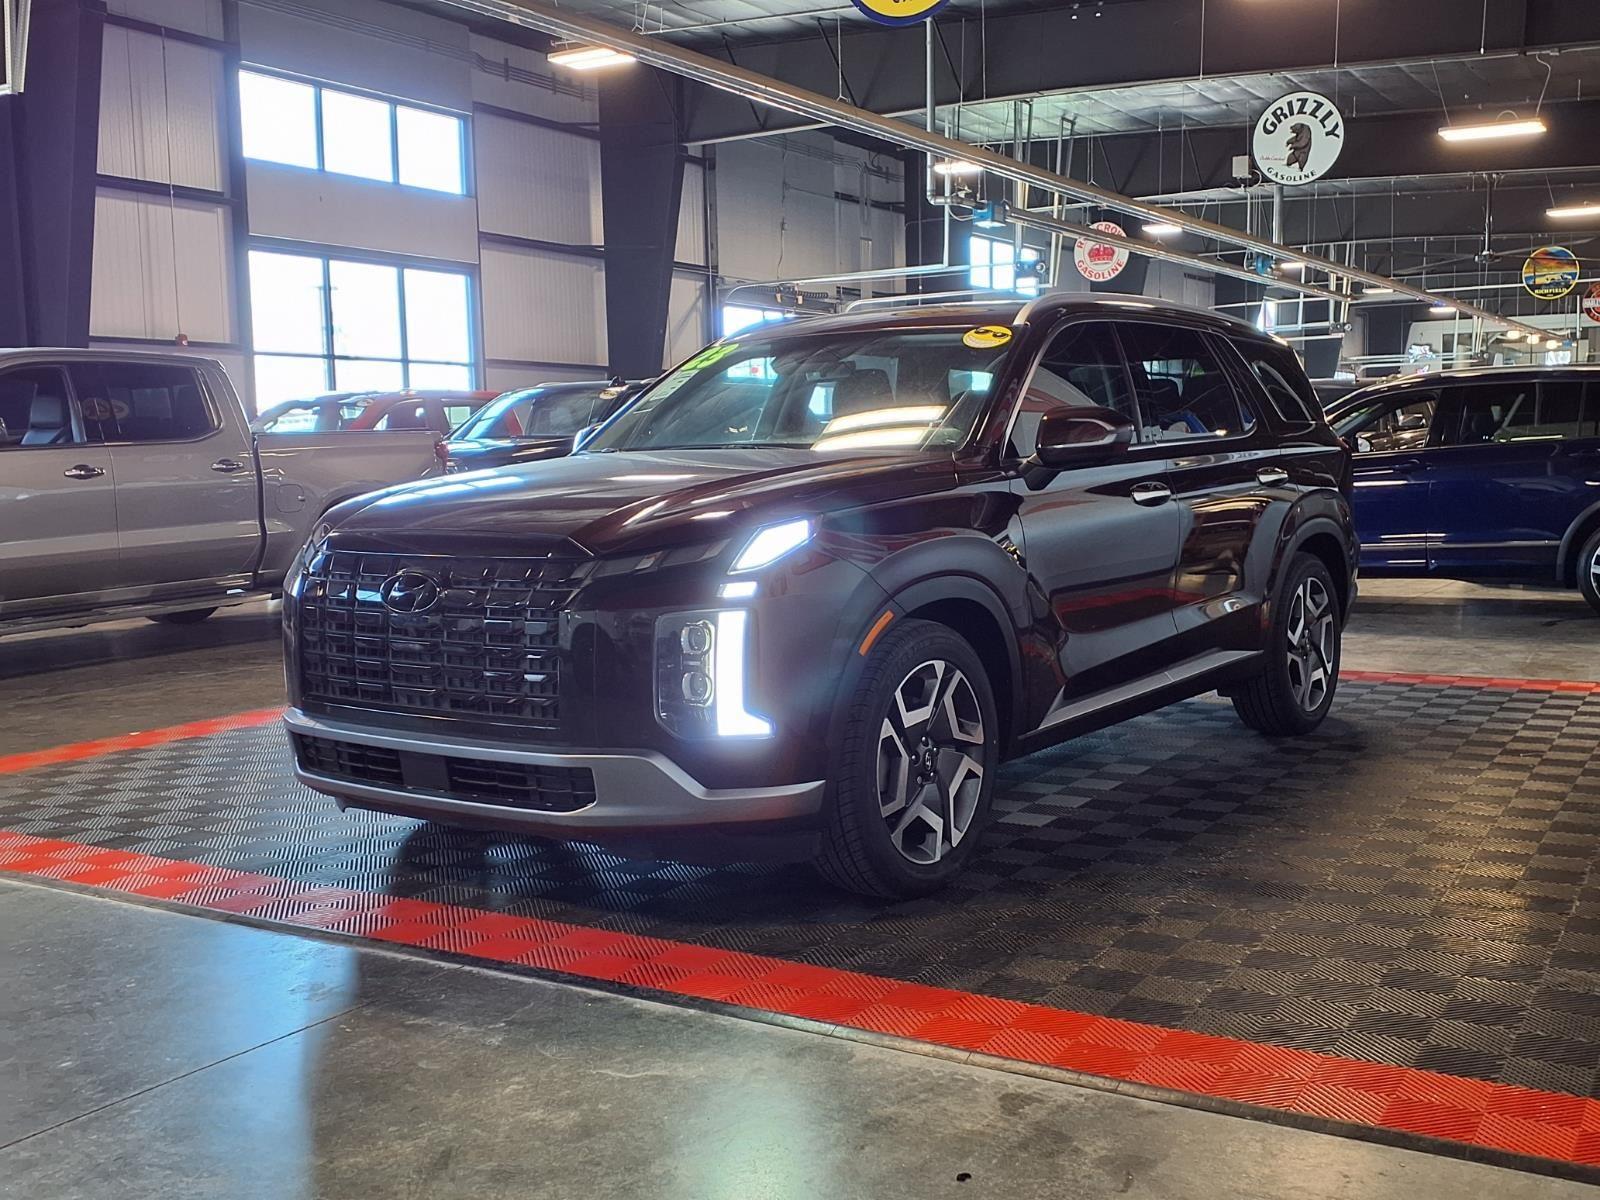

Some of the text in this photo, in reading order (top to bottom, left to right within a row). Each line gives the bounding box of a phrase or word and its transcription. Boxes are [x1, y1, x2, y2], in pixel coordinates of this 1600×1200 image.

[1262, 97, 1340, 139] GRIZZLY
[1266, 166, 1317, 182] GASOLINE
[1096, 223, 1124, 236] CRO
[1077, 259, 1124, 280] GASOLINE
